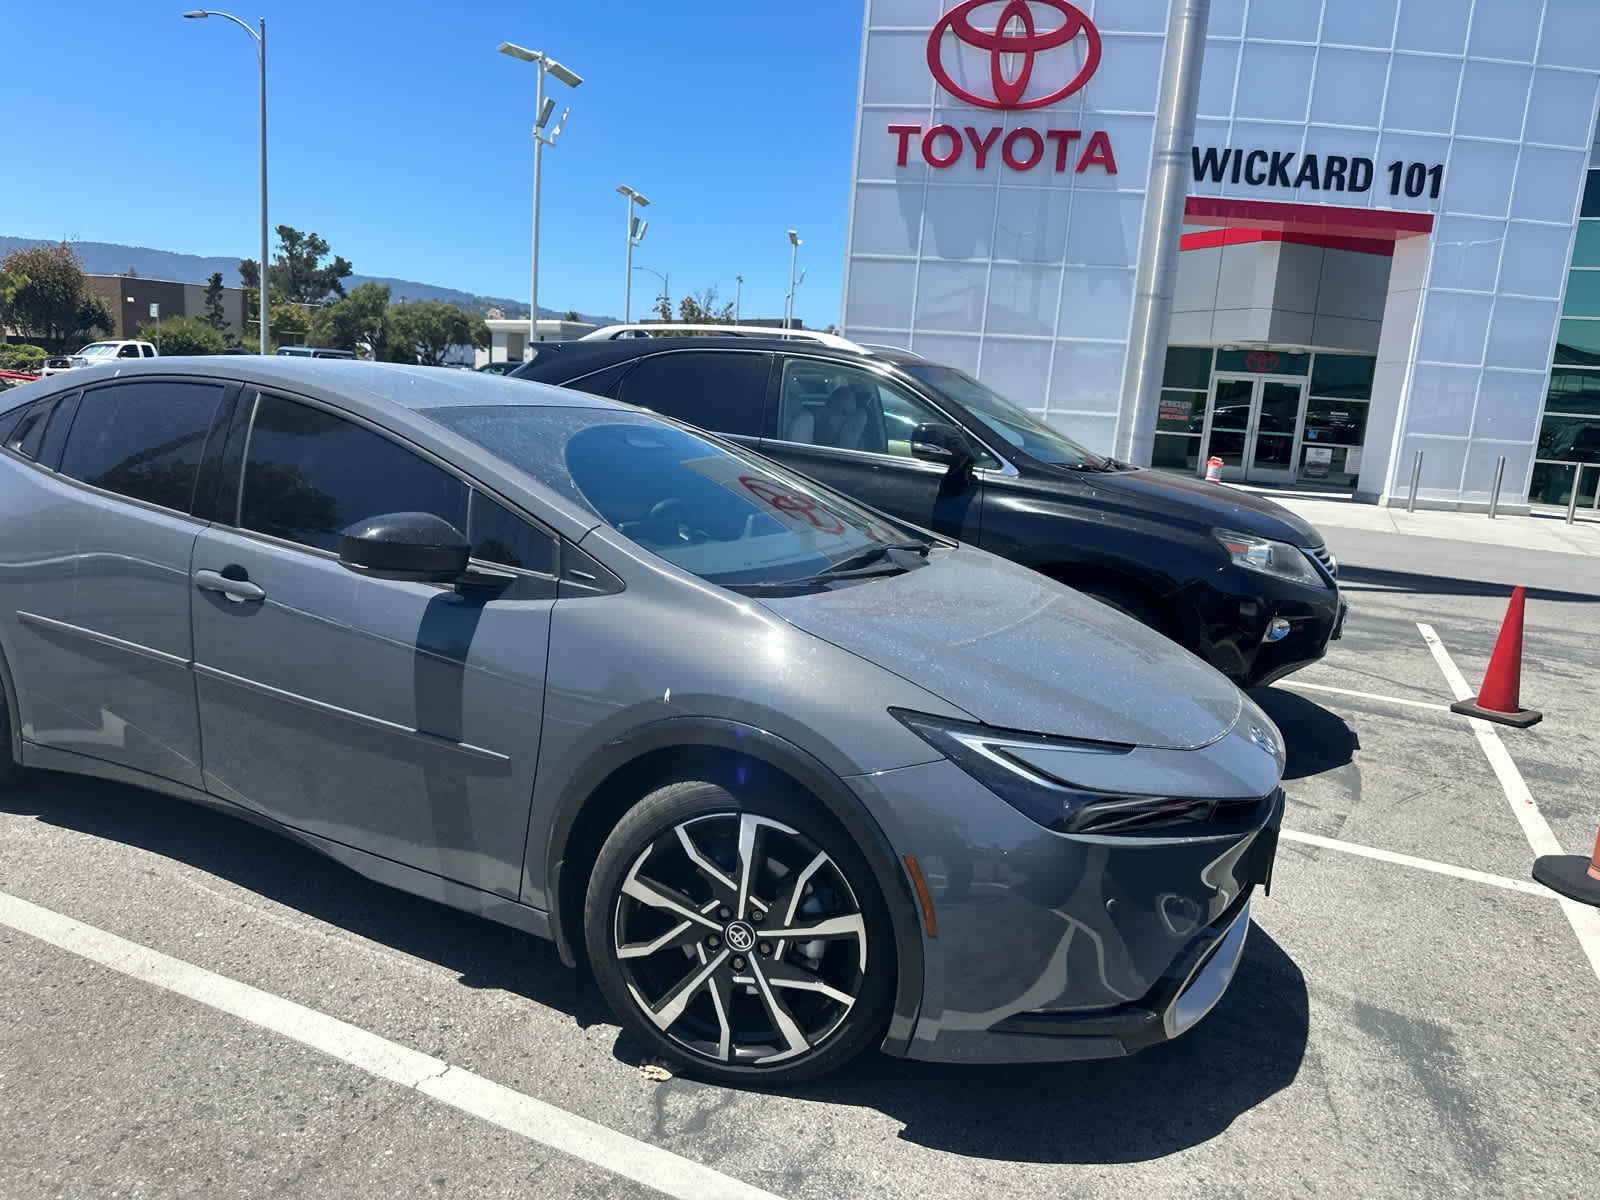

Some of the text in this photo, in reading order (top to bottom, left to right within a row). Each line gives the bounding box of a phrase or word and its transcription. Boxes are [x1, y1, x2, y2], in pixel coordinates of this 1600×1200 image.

[887, 124, 1118, 174] TOYOTA
[1192, 146, 1443, 199] WICKARD 101
